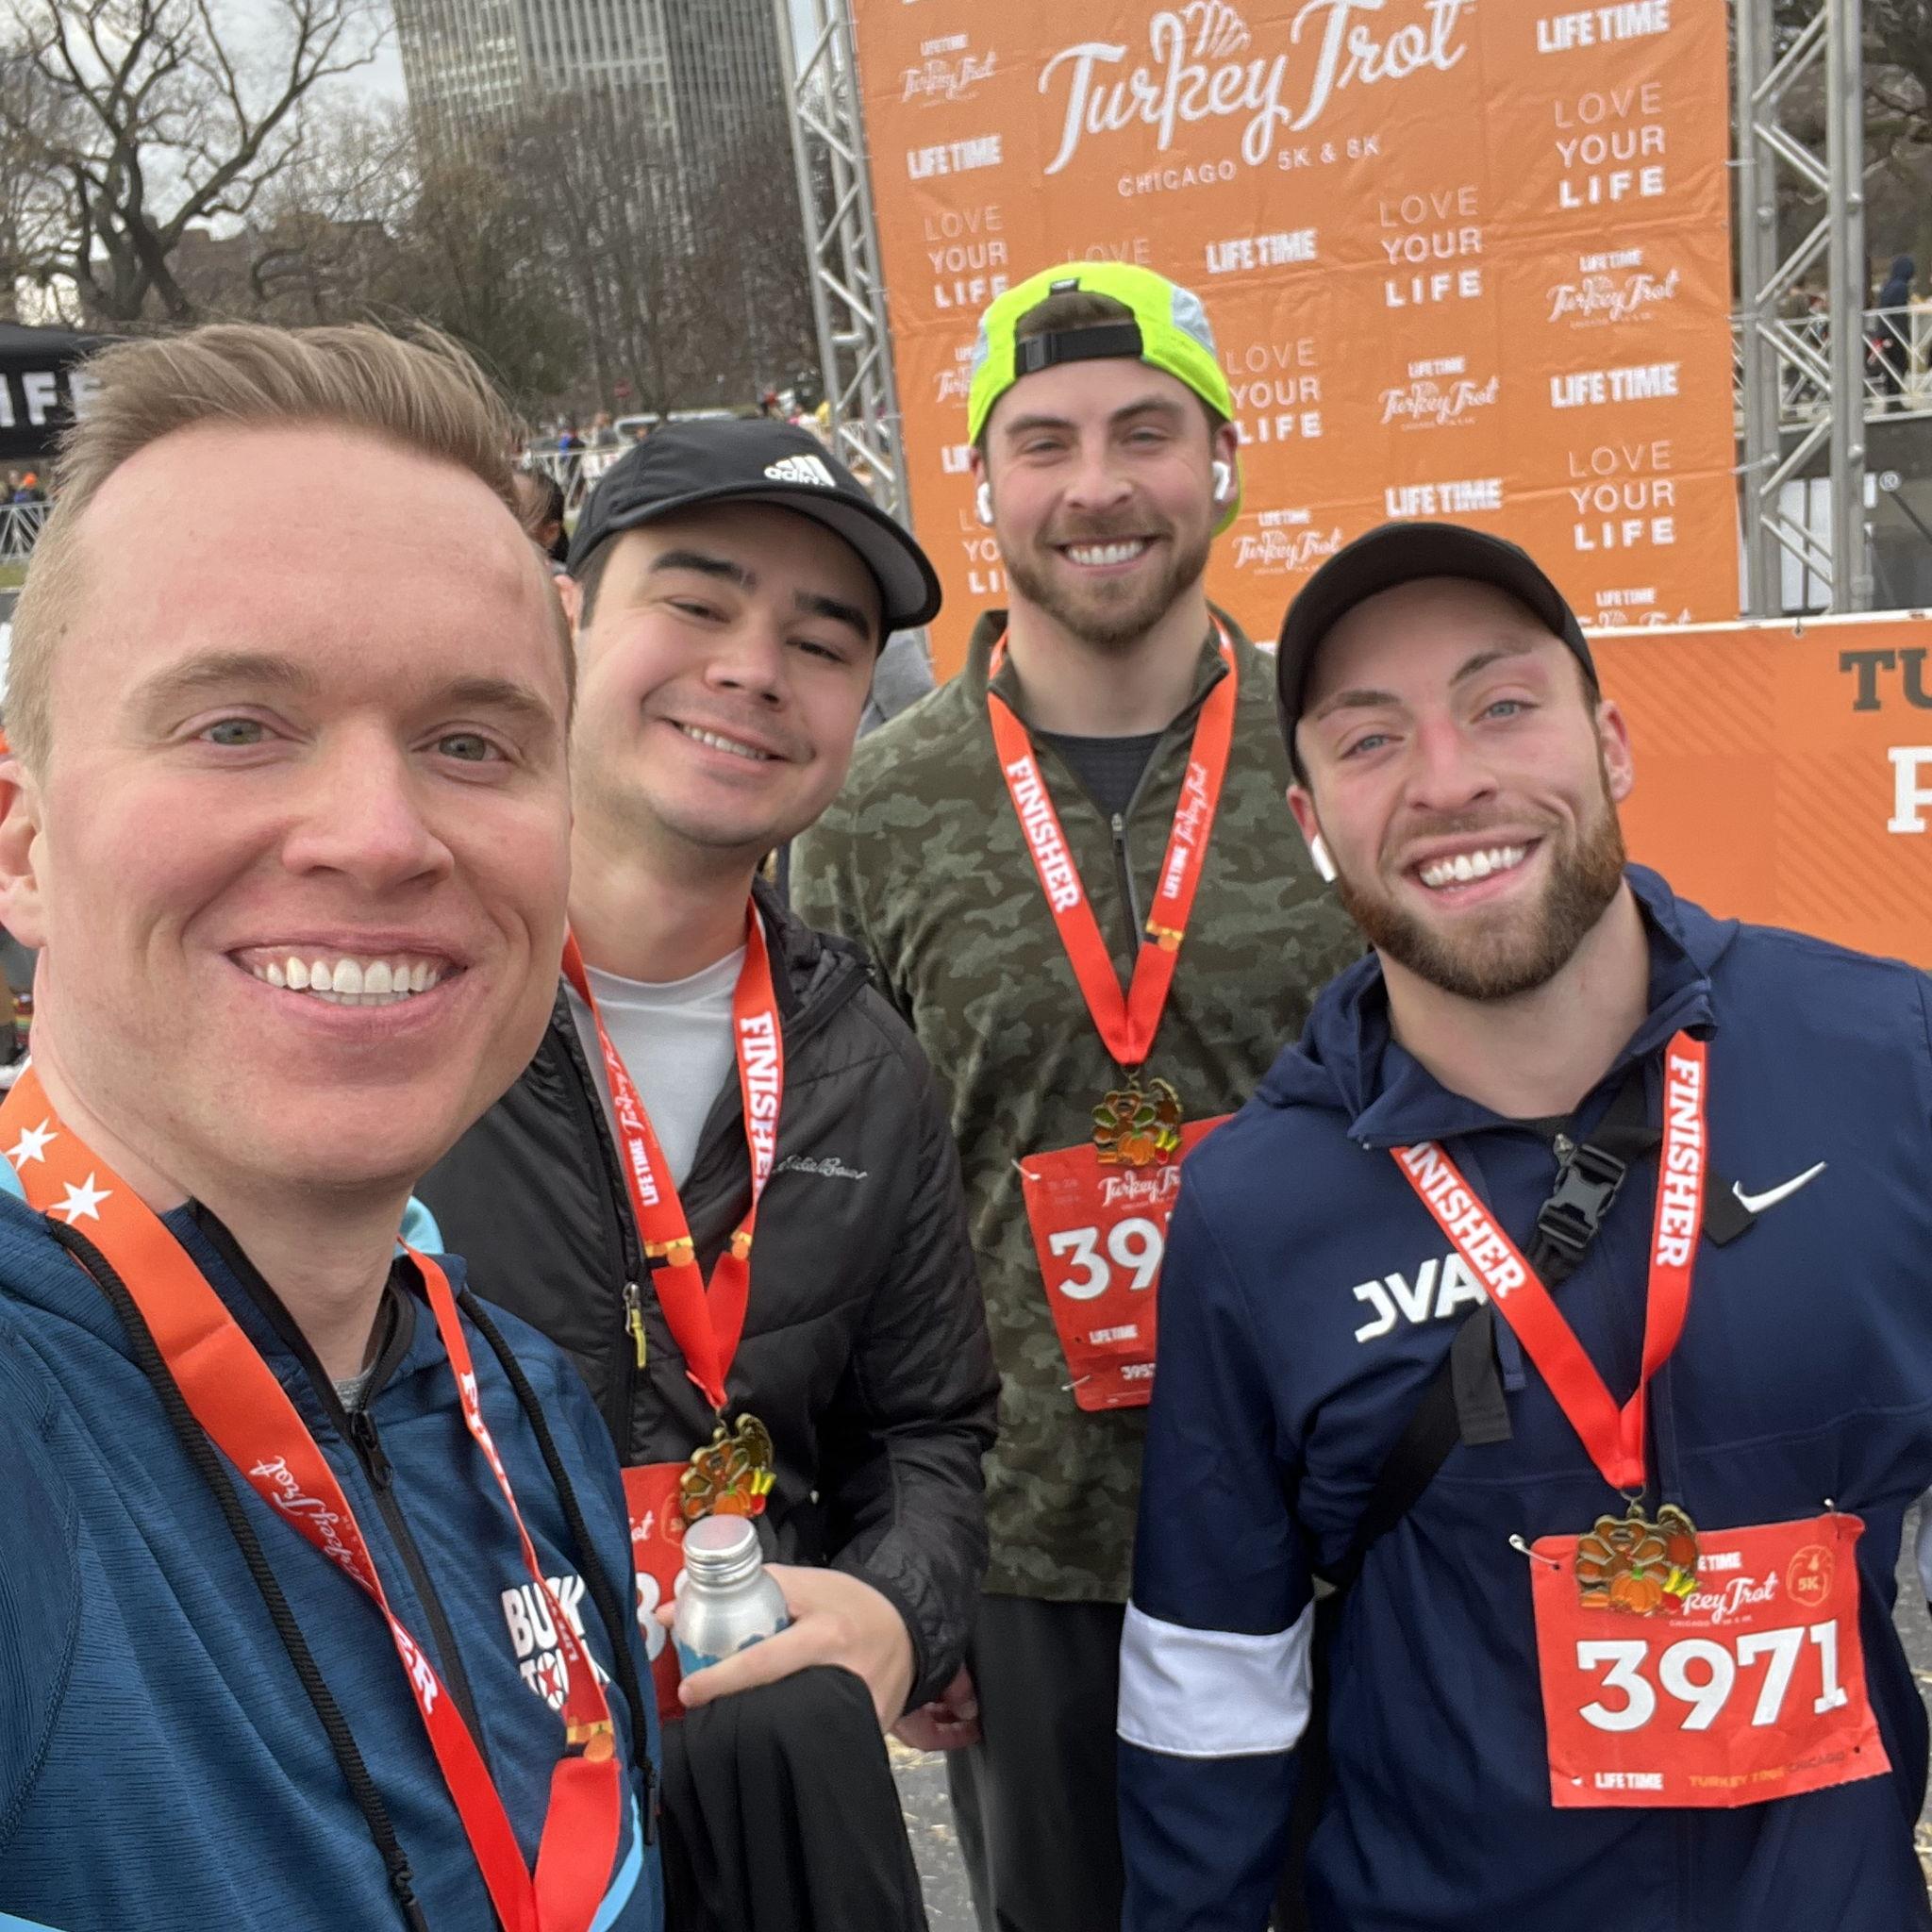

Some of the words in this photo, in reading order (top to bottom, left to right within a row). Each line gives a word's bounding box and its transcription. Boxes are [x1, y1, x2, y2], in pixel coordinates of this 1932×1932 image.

[1038, 11, 1292, 175] Turkey
[1291, 0, 1469, 131] Trot
[1554, 82, 1663, 129] LOVE
[1555, 124, 1667, 168] YOUR
[1118, 159, 1237, 196] CHICAGO
[1277, 147, 1312, 171] 5K
[1320, 142, 1336, 164] &
[1559, 166, 1666, 208] LIFE
[924, 206, 1003, 241] LOVE
[1379, 186, 1479, 229] LOVE
[928, 241, 1008, 274] YOUR
[1380, 226, 1483, 267] YOUR
[934, 275, 1008, 308] LIFE
[1385, 269, 1482, 308] LIFE
[1225, 337, 1319, 375] LOVE
[1228, 375, 1321, 409] YOUR
[1233, 410, 1323, 444] LIFE
[1568, 439, 1673, 478] LOVE
[1569, 479, 1675, 516] YOUR
[962, 538, 1002, 562] YO
[1574, 516, 1674, 552] LIFE
[1007, 755, 1081, 914] FINISHER
[1657, 1054, 1701, 1269] FINISHER
[1097, 1170, 1159, 1207] Turkey
[1049, 1212, 1173, 1300] 39
[1725, 1571, 1778, 1615] Trot
[1798, 1576, 1819, 1591] 5K
[1576, 1619, 1848, 1732] 3971
